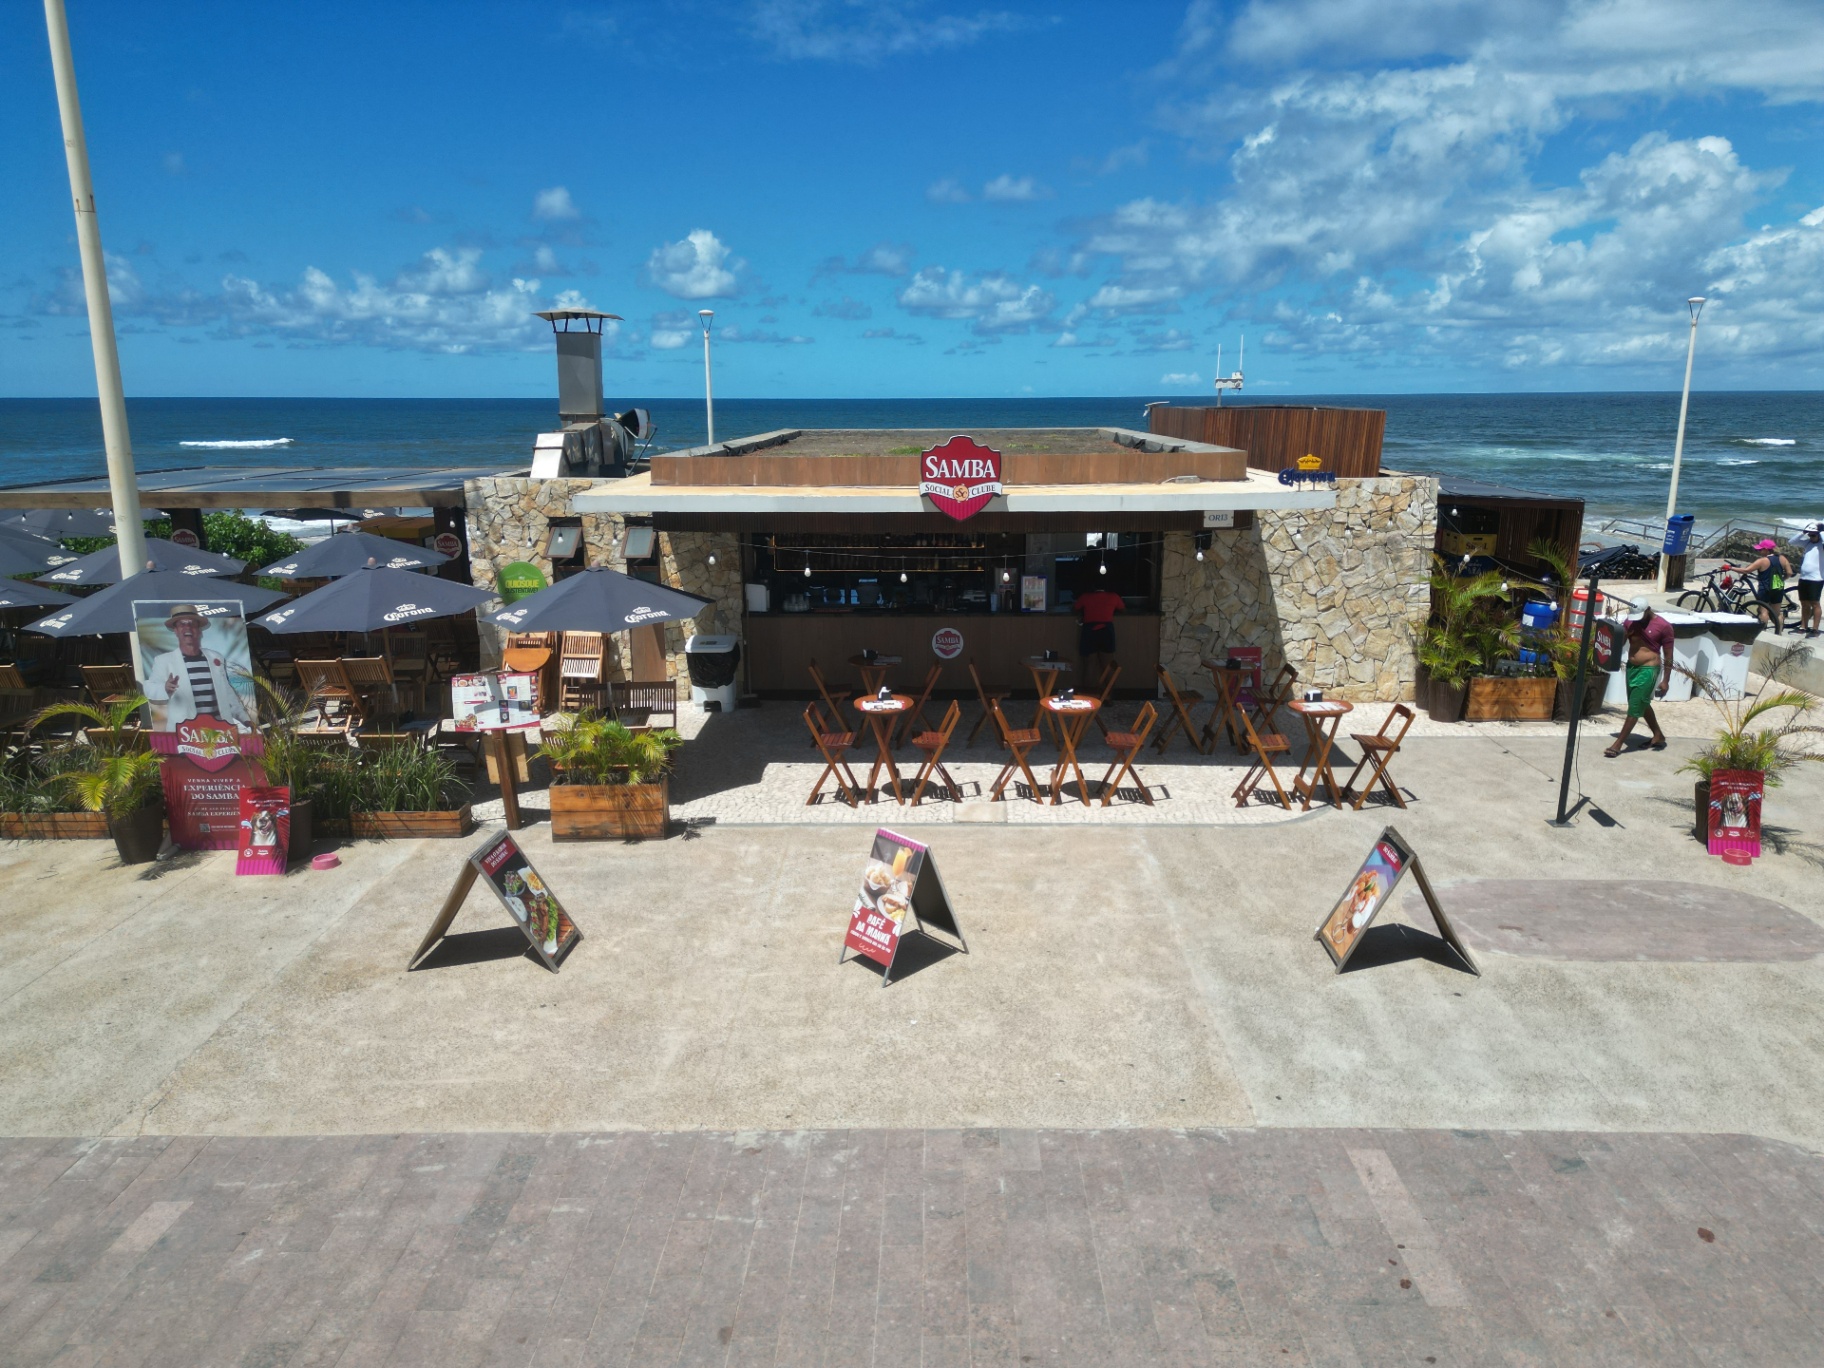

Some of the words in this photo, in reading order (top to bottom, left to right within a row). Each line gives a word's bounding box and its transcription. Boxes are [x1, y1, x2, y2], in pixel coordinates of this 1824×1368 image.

[925, 455, 997, 479] SAMBA
[924, 483, 952, 497] SOCIAL
[971, 484, 996, 496] CLUBE
[505, 579, 539, 588] QUIOSQUE
[197, 606, 231, 617] rona
[383, 606, 436, 622] Corona
[624, 609, 671, 623] Corona
[936, 636, 960, 644] SAMBA
[180, 726, 235, 743] SAMBA
[191, 792, 205, 800] DO
[206, 792, 240, 800] SAMBA
[855, 921, 866, 933] DA
[866, 913, 886, 929] CAFÉ
